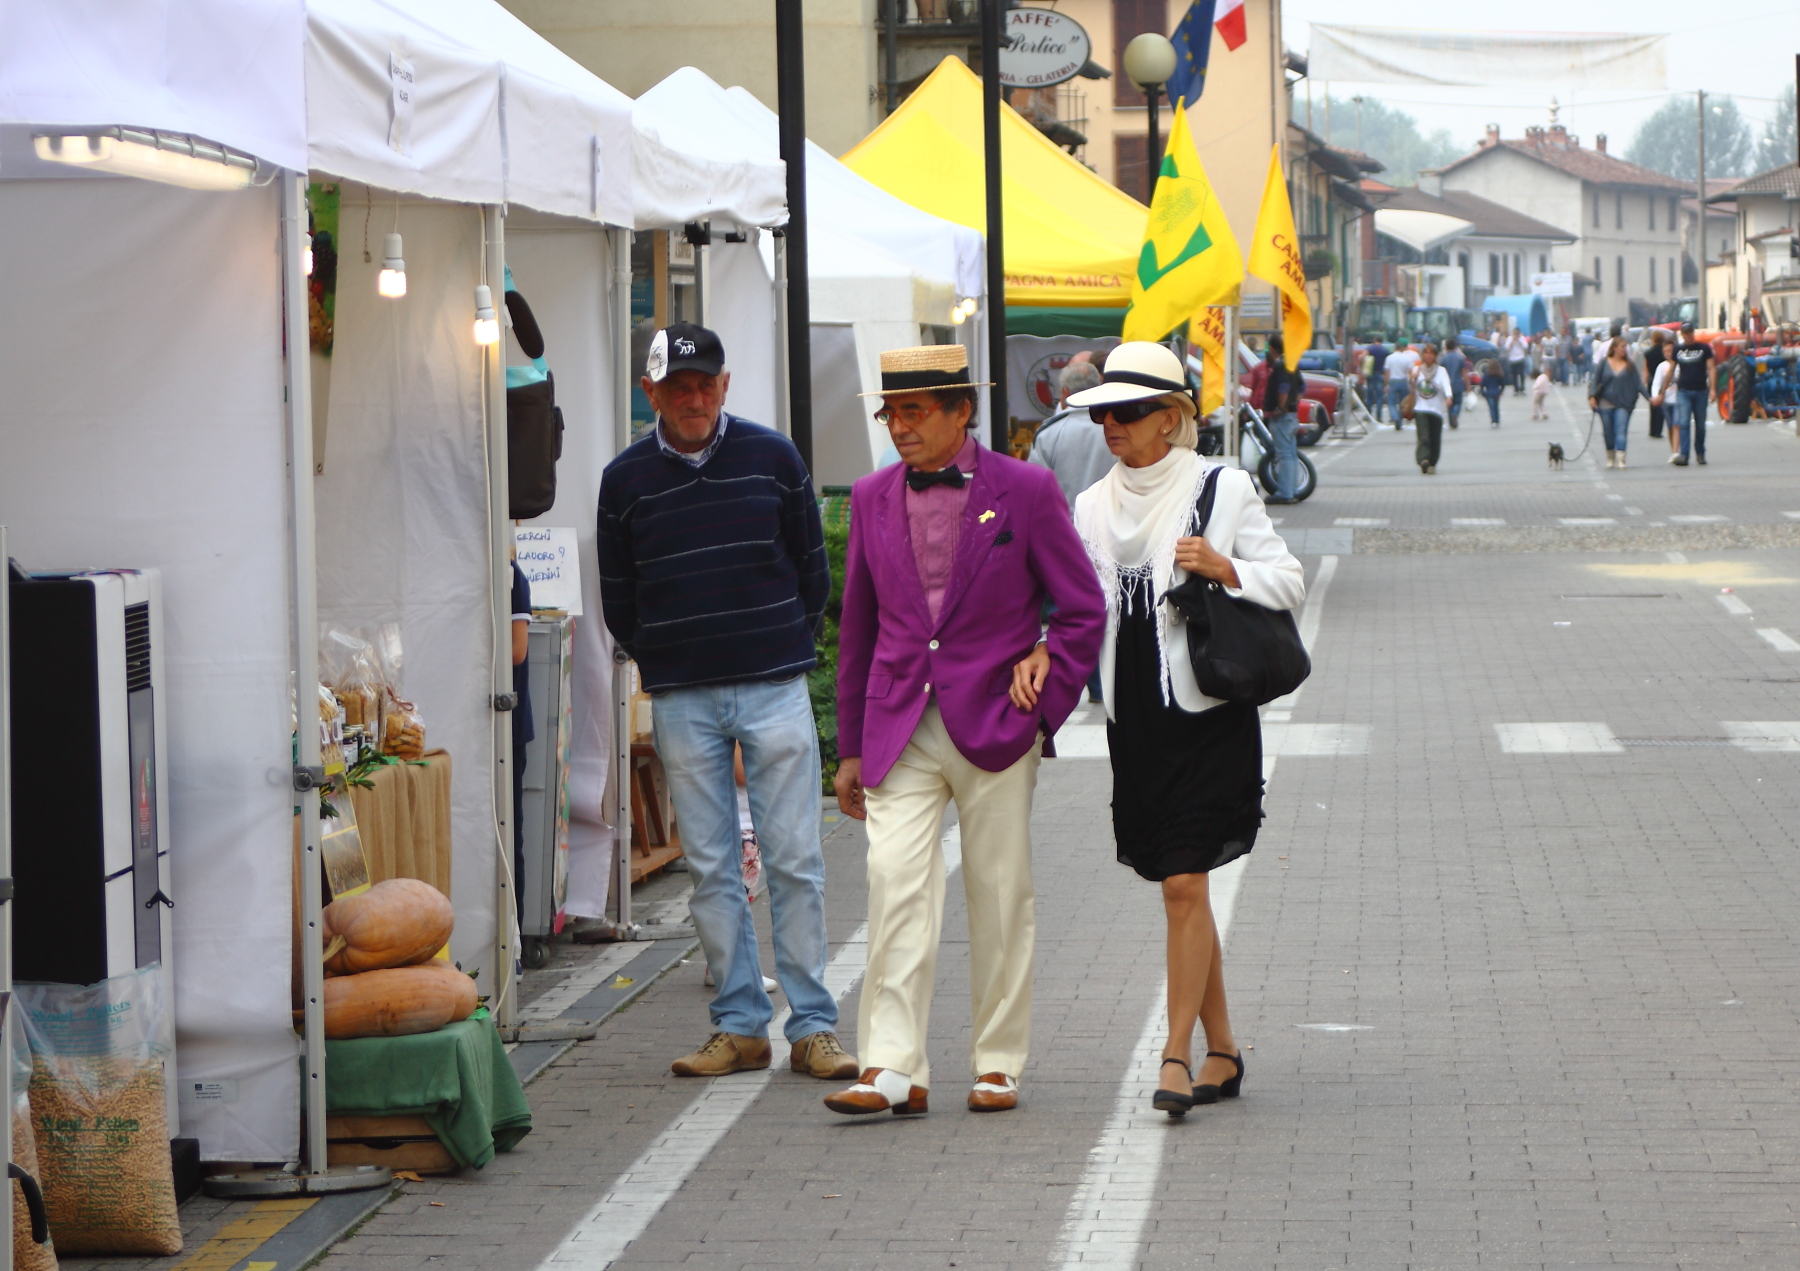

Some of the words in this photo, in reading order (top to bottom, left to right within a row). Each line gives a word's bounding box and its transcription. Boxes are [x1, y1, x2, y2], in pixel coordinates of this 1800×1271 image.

[1008, 12, 1060, 27] AFFE'
[998, 71, 1016, 82] RIA
[1026, 61, 1078, 84] GELATERIA
[1003, 274, 1057, 287] PAGNA
[1064, 274, 1122, 287] AMICA
